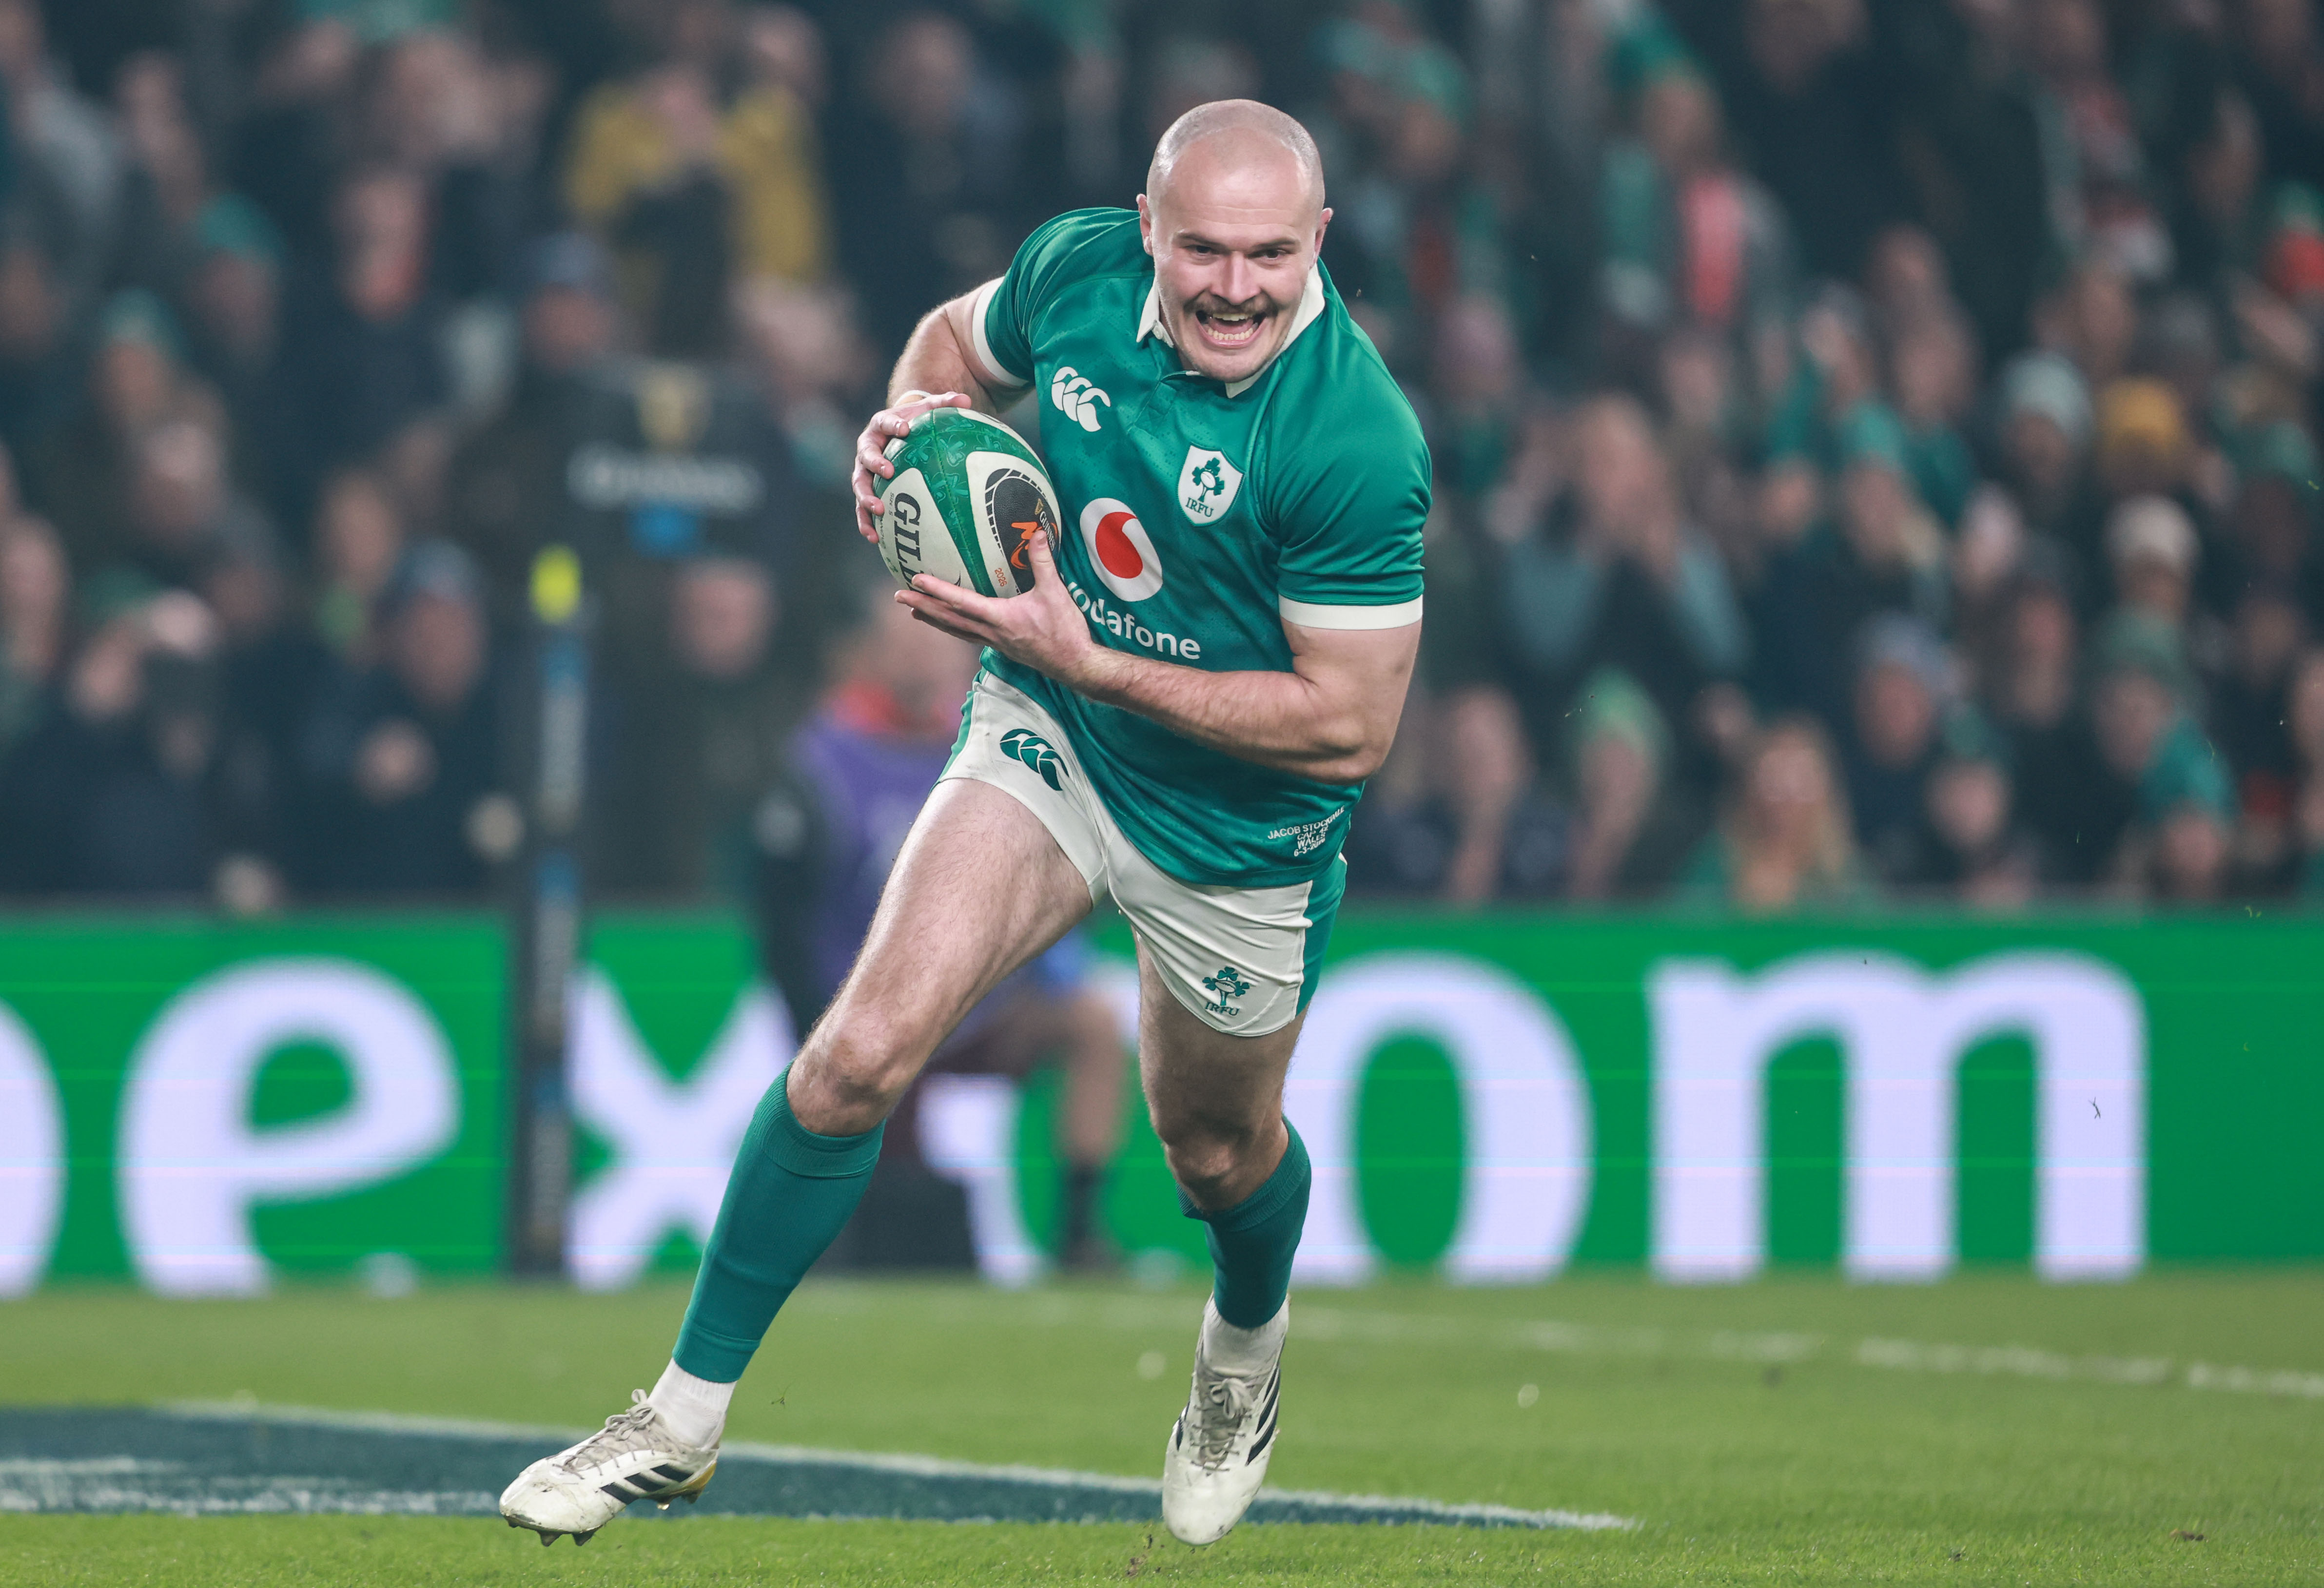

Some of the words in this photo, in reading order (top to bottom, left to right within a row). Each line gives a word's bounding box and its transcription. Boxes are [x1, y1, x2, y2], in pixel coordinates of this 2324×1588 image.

[1186, 497, 1214, 517] IRFU
[1039, 511, 1055, 551] GUINNESS
[995, 568, 1007, 586] 2026
[1268, 826, 1301, 839] JACOB
[1297, 832, 1326, 850] WALES
[1205, 1002, 1240, 1016] IRFU
